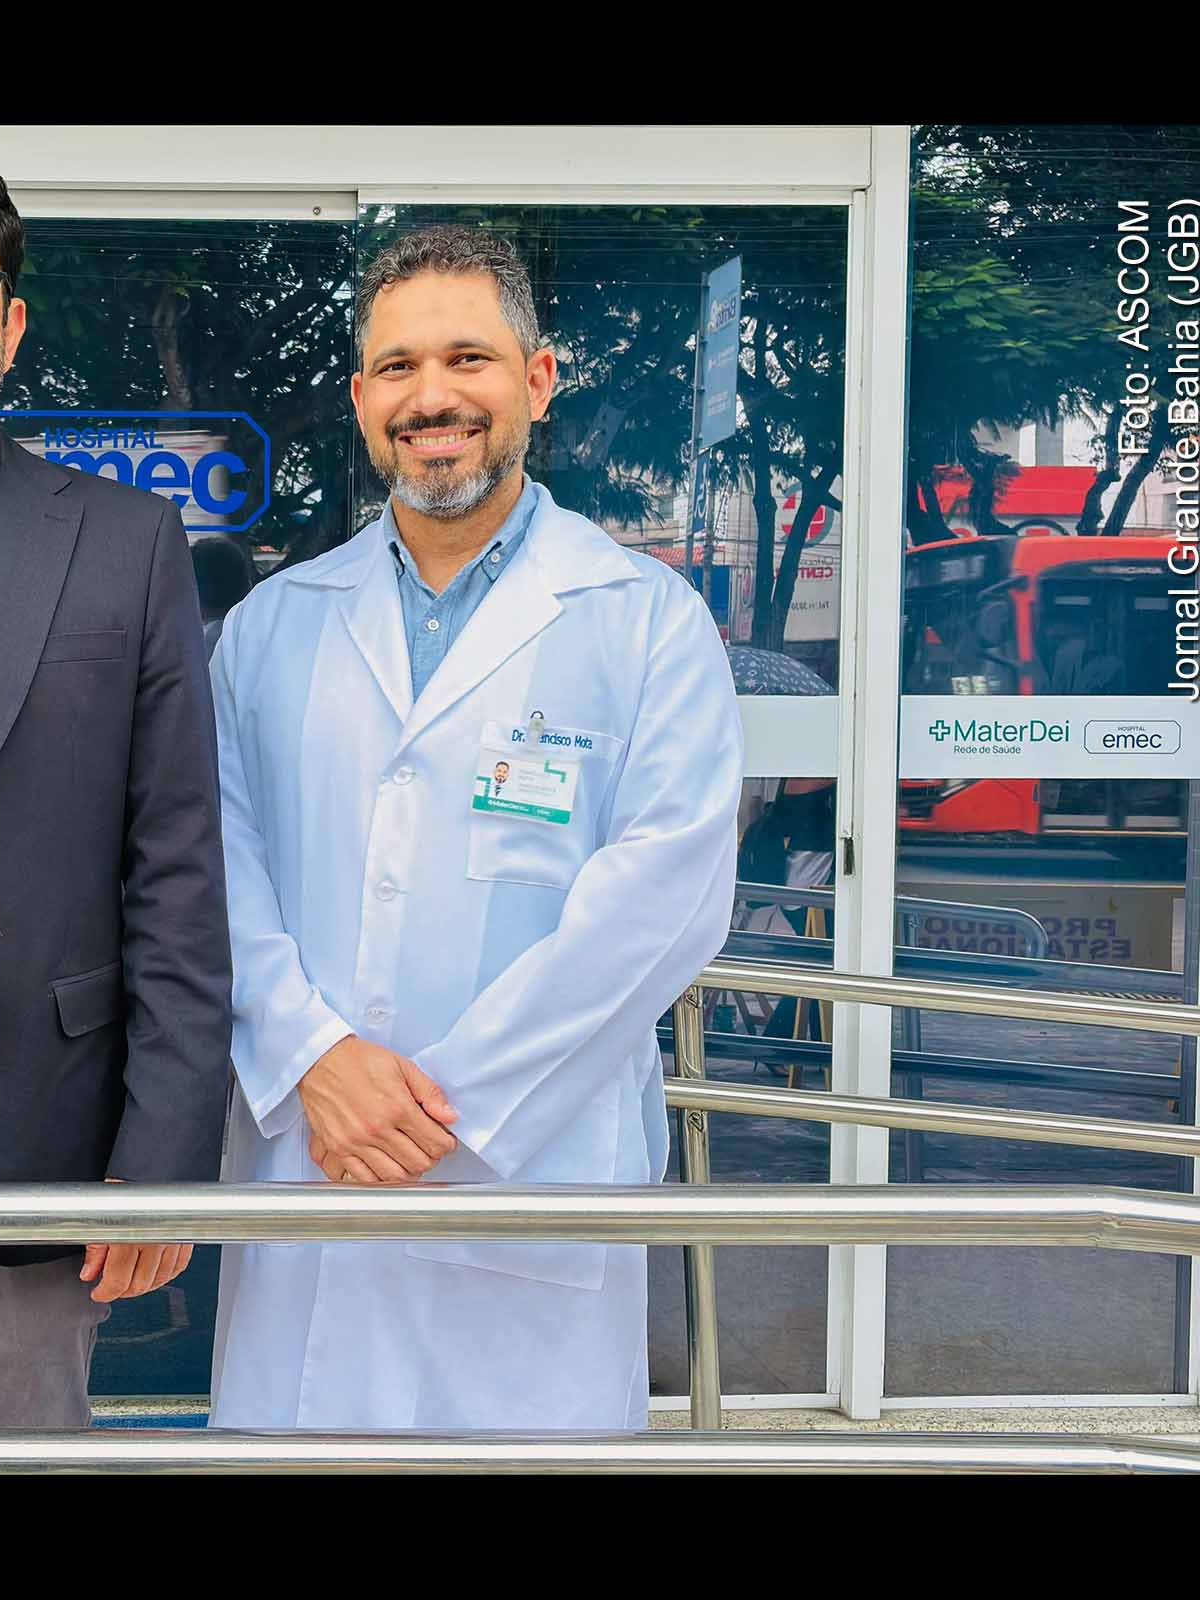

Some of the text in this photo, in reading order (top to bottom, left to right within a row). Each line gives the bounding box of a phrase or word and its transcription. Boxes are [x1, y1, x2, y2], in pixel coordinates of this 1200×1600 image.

[44, 428, 164, 449] HOSPITAL
[45, 451, 248, 515] ec
[511, 729, 593, 750] Dr. ancisco Mota
[953, 720, 1070, 742] MaterDei
[1102, 733, 1163, 749] emec
[953, 745, 1021, 754] Rede de Saúde
